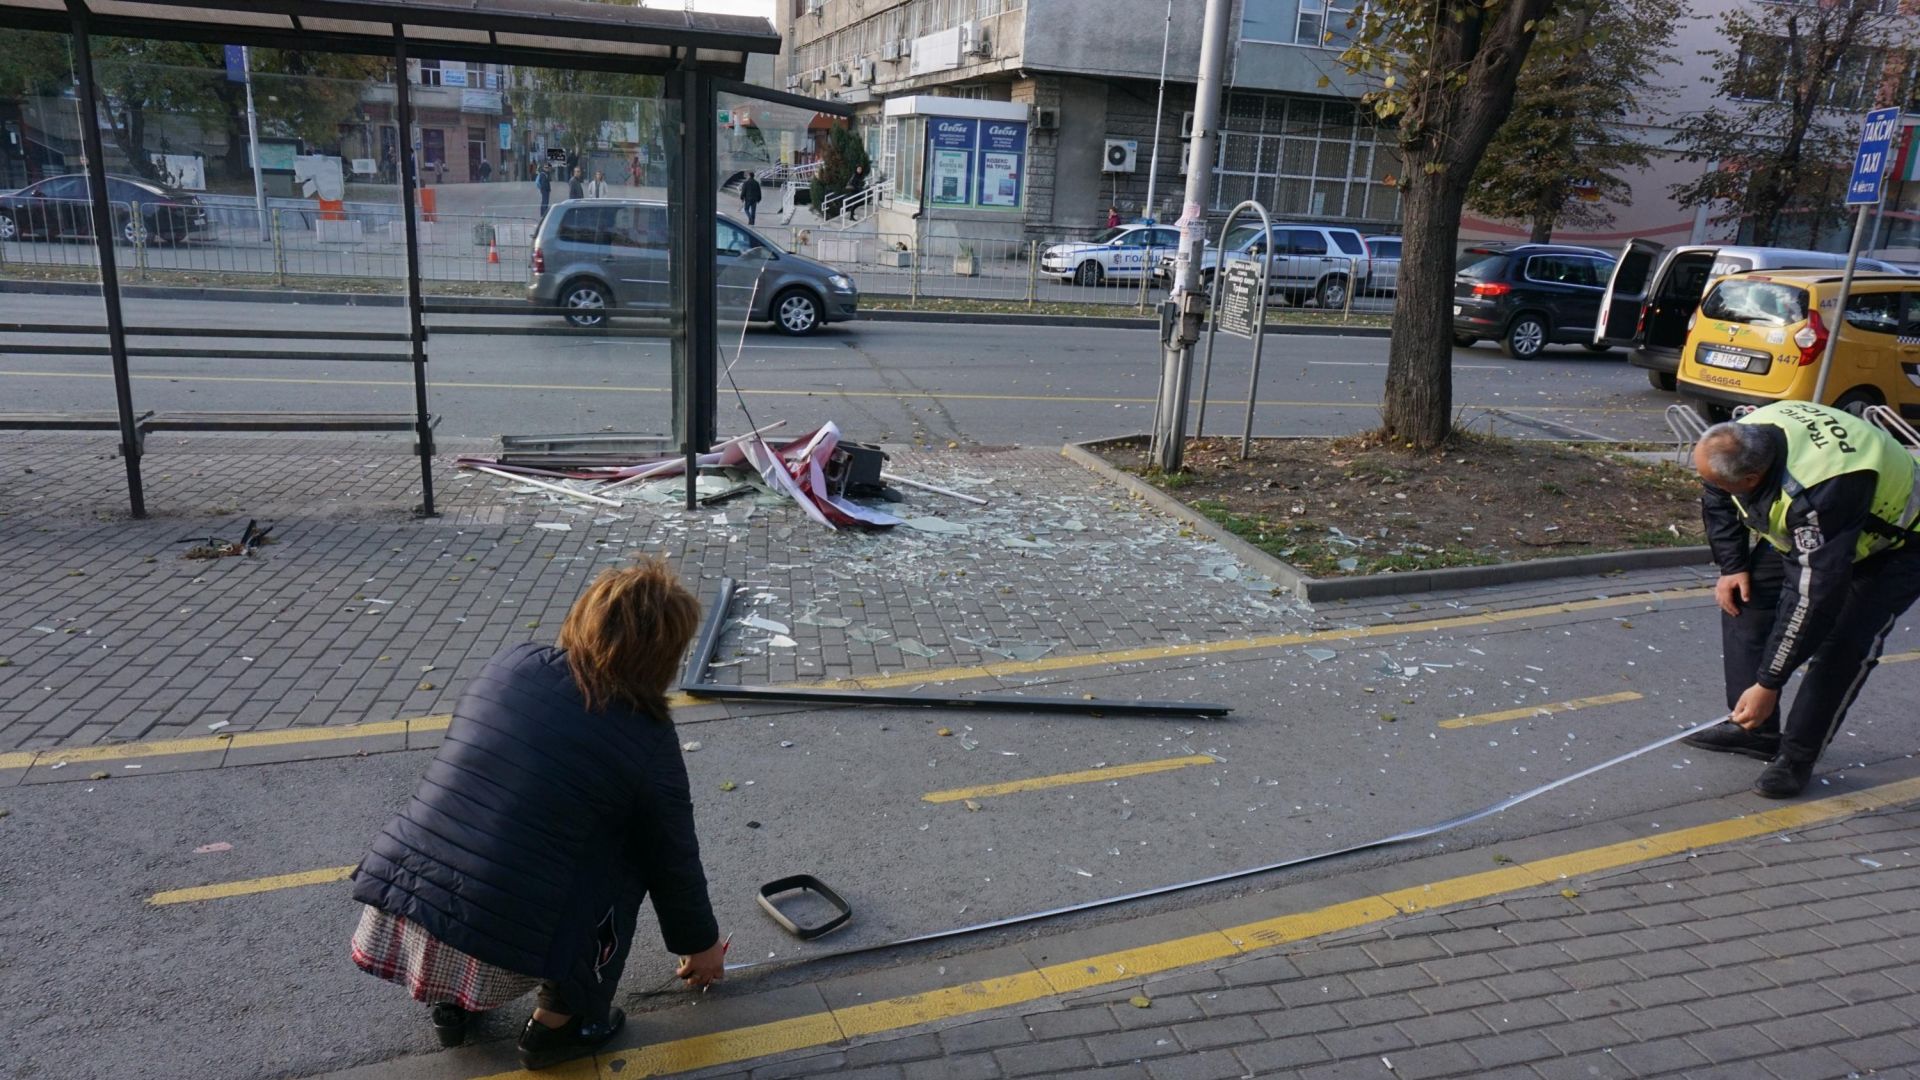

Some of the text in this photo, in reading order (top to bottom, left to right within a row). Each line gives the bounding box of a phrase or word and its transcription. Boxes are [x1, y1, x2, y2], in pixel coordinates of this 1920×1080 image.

[1864, 119, 1895, 142] ТАКСИ
[1860, 152, 1881, 174] TAXI
[1777, 353, 1799, 366] 447
[1779, 407, 1829, 450] TRAFFIC
[1793, 403, 1857, 454] POLICE
[1769, 604, 1809, 673] TRAFFIC POLICE
